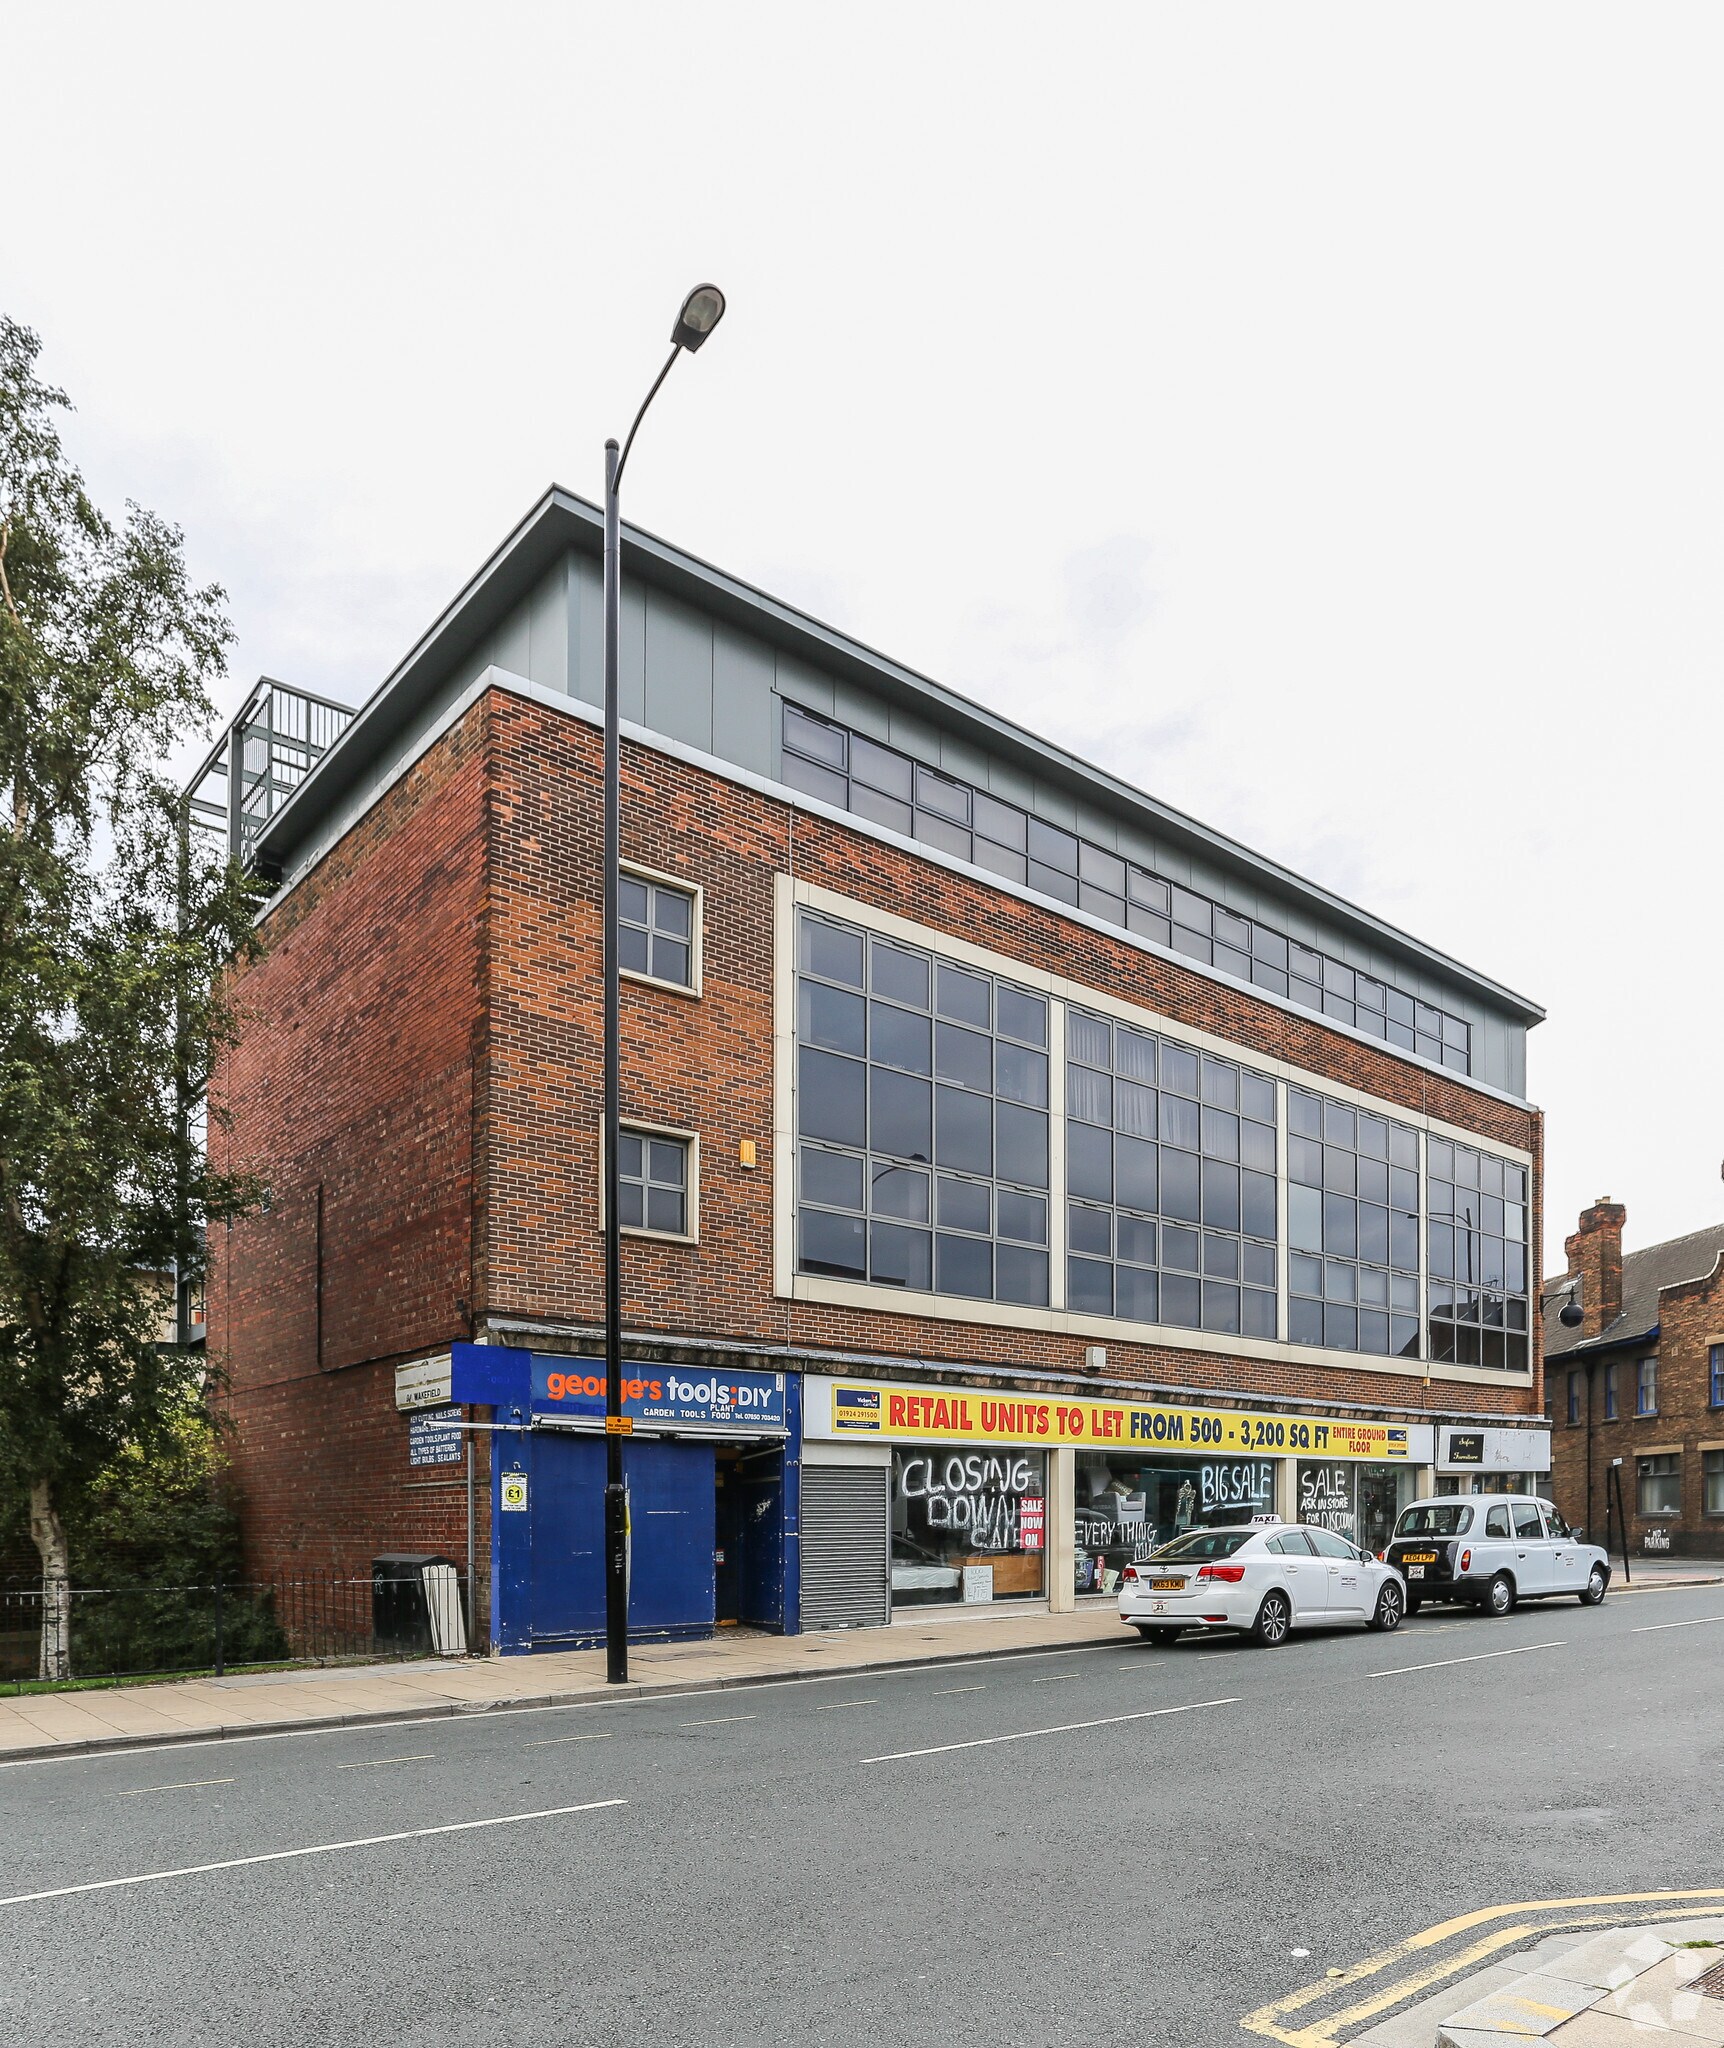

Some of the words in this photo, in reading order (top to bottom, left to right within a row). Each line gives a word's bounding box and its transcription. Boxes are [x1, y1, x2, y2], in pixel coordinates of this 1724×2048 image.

[414, 1388, 441, 1401] WAKEFIELD
[643, 1408, 674, 1417] GARDEN
[681, 1410, 706, 1419] TOOLS
[711, 1411, 730, 1420] FOOD
[710, 1404, 735, 1413] PLANT
[889, 1395, 973, 1430] RETAIL
[981, 1402, 1049, 1435] UNITS
[1056, 1407, 1084, 1436] TO
[1092, 1409, 1123, 1437] LET
[1130, 1412, 1184, 1441] FROM
[1190, 1417, 1223, 1443] 500
[1241, 1421, 1284, 1450] 3,200
[1289, 1424, 1310, 1449] SQ
[1315, 1426, 1329, 1449] FT
[410, 1436, 424, 1445] GARDEN
[451, 1432, 461, 1440] FOOD
[1332, 1426, 1355, 1439] ENTIRE
[1357, 1428, 1386, 1442] GROUND
[418, 1446, 429, 1455] TYPES
[436, 1443, 456, 1453] BATTERIES
[1348, 1441, 1371, 1453] FLOOR
[438, 1452, 461, 1462] SEALANTS
[902, 1456, 1033, 1497] CLOSING
[1202, 1465, 1229, 1503] BIG
[1230, 1463, 1272, 1501] SALE
[1301, 1468, 1346, 1498] SALE
[508, 1489, 519, 1497] £1
[1020, 1499, 1043, 1513] SALE
[1300, 1497, 1316, 1510] ASK
[1318, 1498, 1327, 1510] IN
[1327, 1496, 1349, 1509] STORE
[927, 1493, 1016, 1528] DOWN
[1020, 1516, 1043, 1529] NOW
[1306, 1512, 1320, 1524] FOR
[1117, 1521, 1157, 1543] THING
[1024, 1533, 1039, 1546] ON
[1645, 1536, 1669, 1549] PARKING
